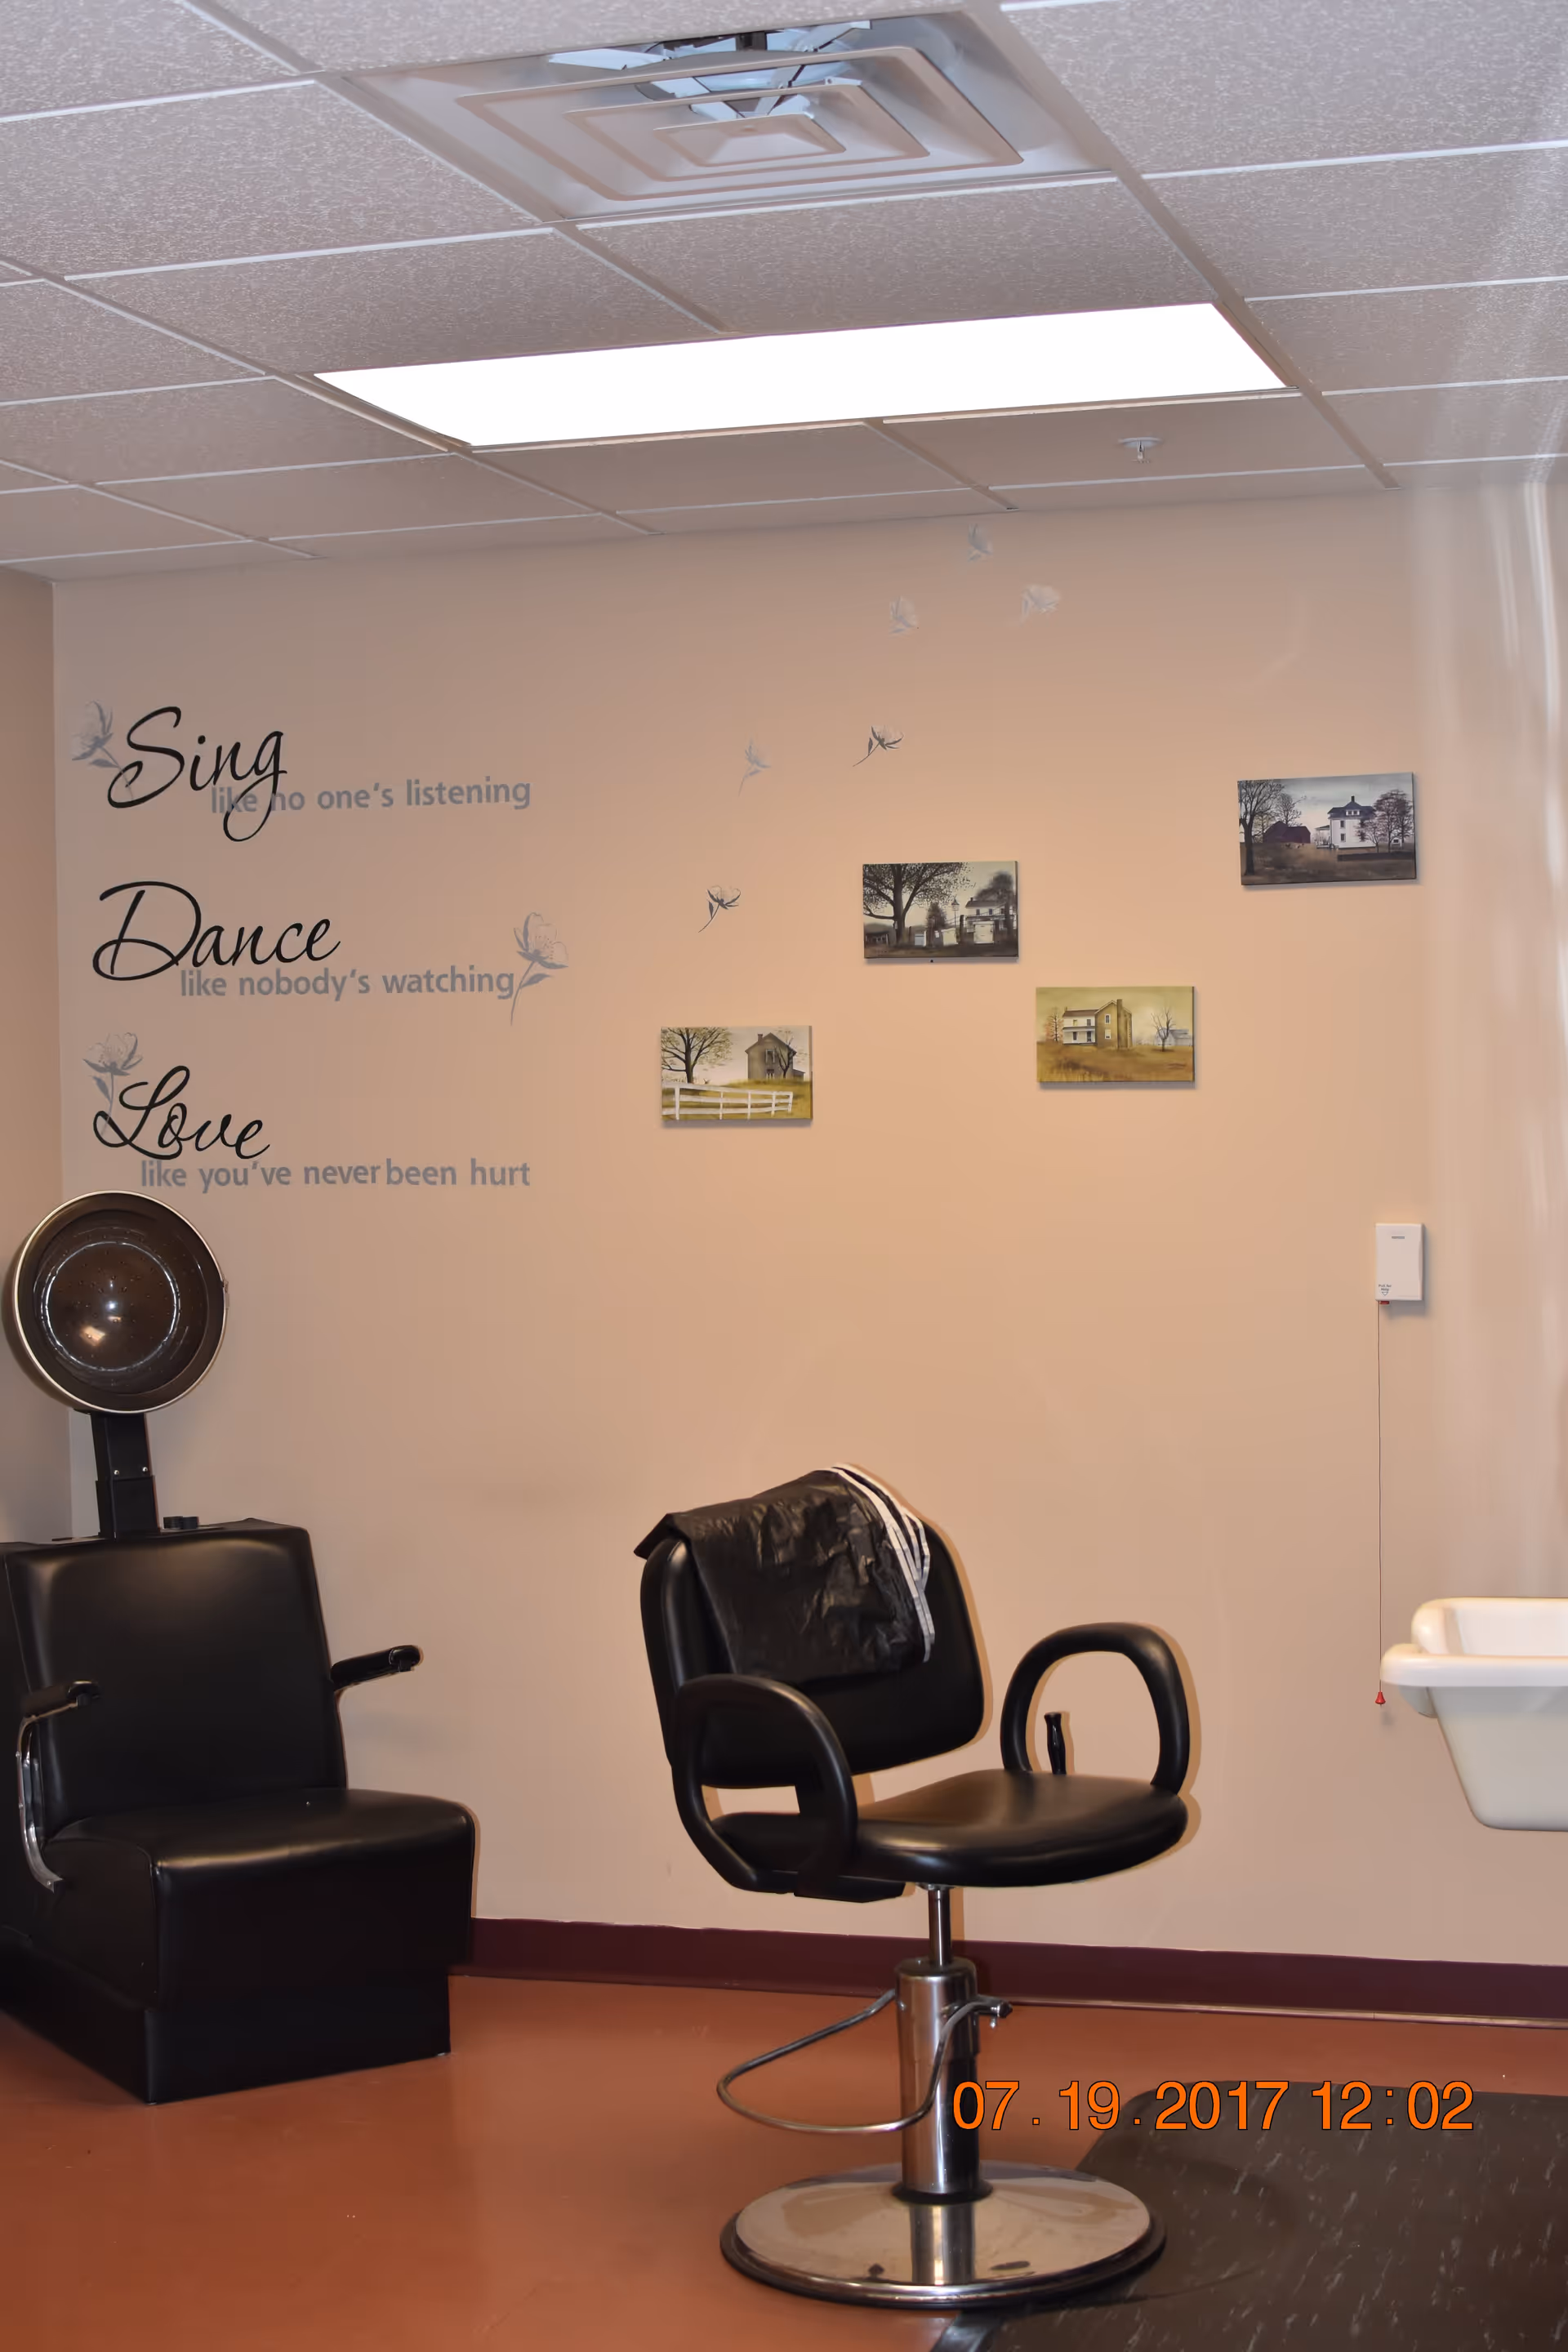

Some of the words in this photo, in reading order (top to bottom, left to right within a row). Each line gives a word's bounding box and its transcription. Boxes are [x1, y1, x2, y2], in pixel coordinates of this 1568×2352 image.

[108, 706, 288, 843] Sing
[212, 786, 257, 814] like
[271, 791, 305, 812] no
[317, 783, 395, 811] one's
[406, 776, 532, 811] listening
[93, 881, 341, 982] Dance
[181, 970, 228, 998] like
[238, 968, 372, 1003] nobody's
[382, 964, 515, 1001] watching
[93, 1066, 271, 1161] Love
[141, 1160, 188, 1188] like
[198, 1161, 292, 1196] you've
[303, 1165, 381, 1187] never
[386, 1159, 458, 1187] been
[470, 1159, 532, 1187] hurt
